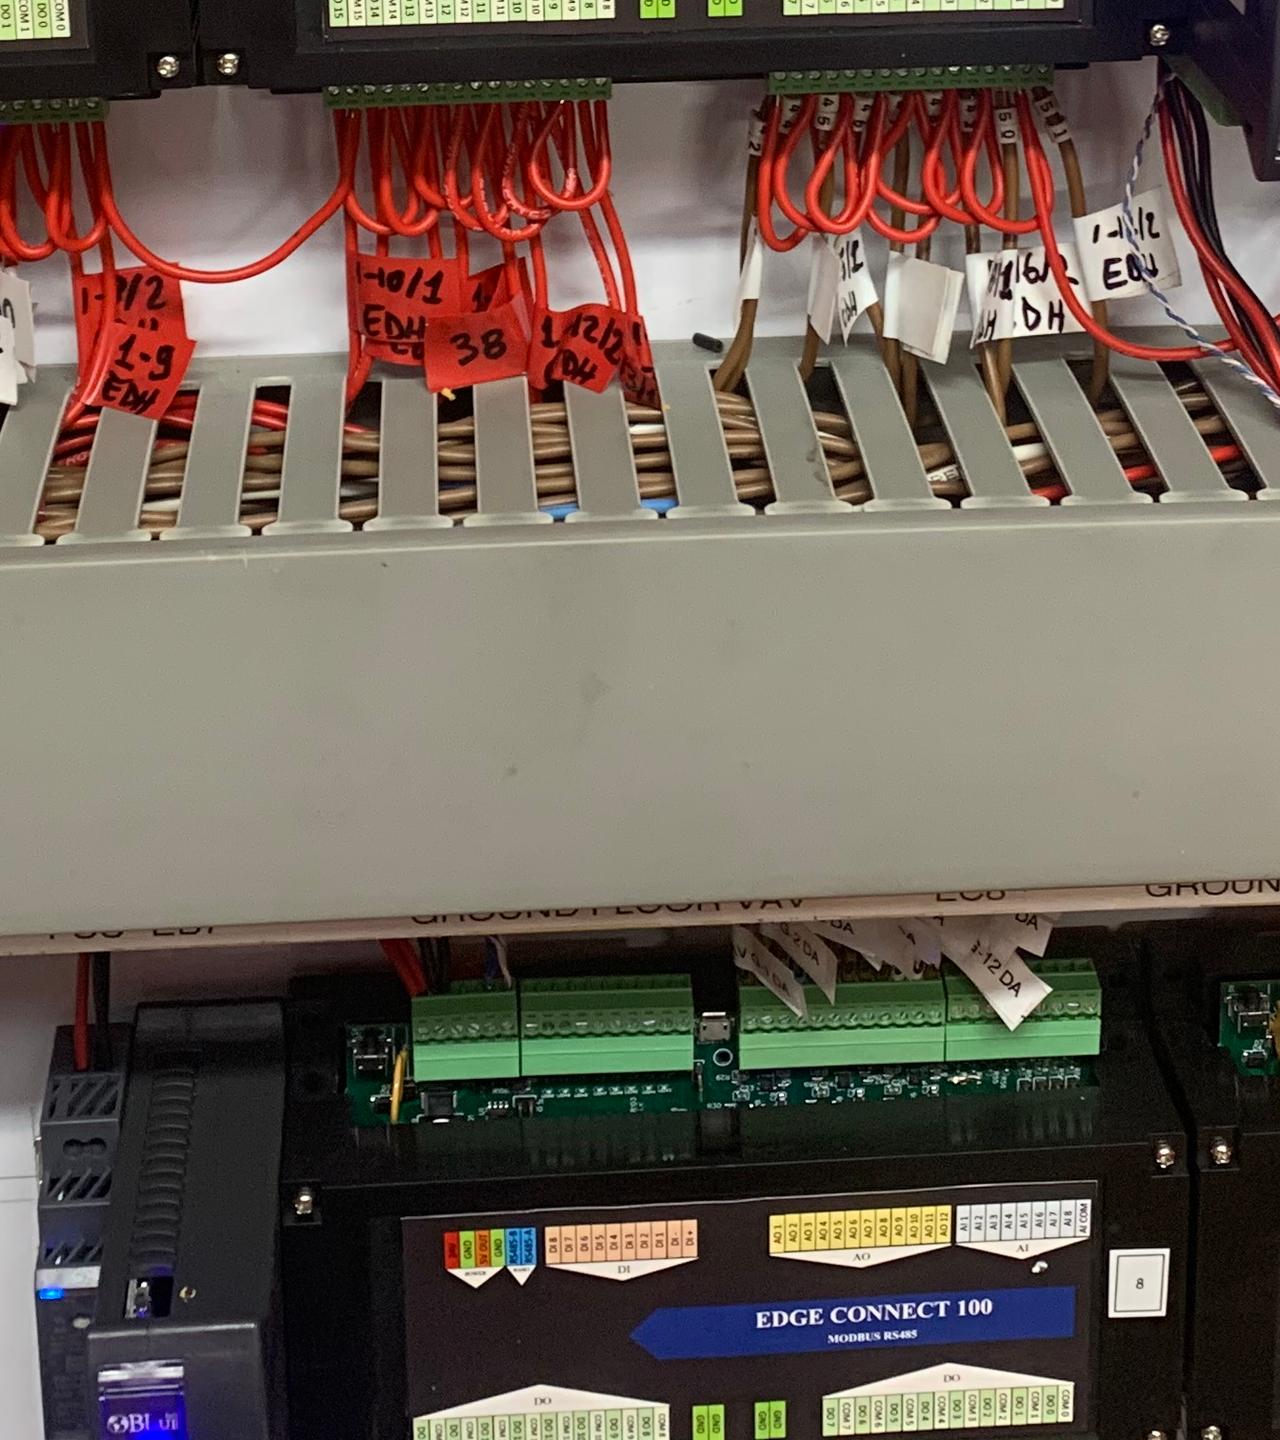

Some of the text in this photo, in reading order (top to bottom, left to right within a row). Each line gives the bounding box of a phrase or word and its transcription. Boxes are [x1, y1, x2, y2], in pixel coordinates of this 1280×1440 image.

[993, 970, 1022, 998] DA
[1018, 1244, 1028, 1252] AI
[855, 1253, 870, 1261] AO
[618, 1265, 630, 1273] DI
[1136, 1278, 1144, 1289] 8
[757, 1299, 992, 1328] EDGE CONNECT 100
[828, 1330, 917, 1343] MODBUS RS485
